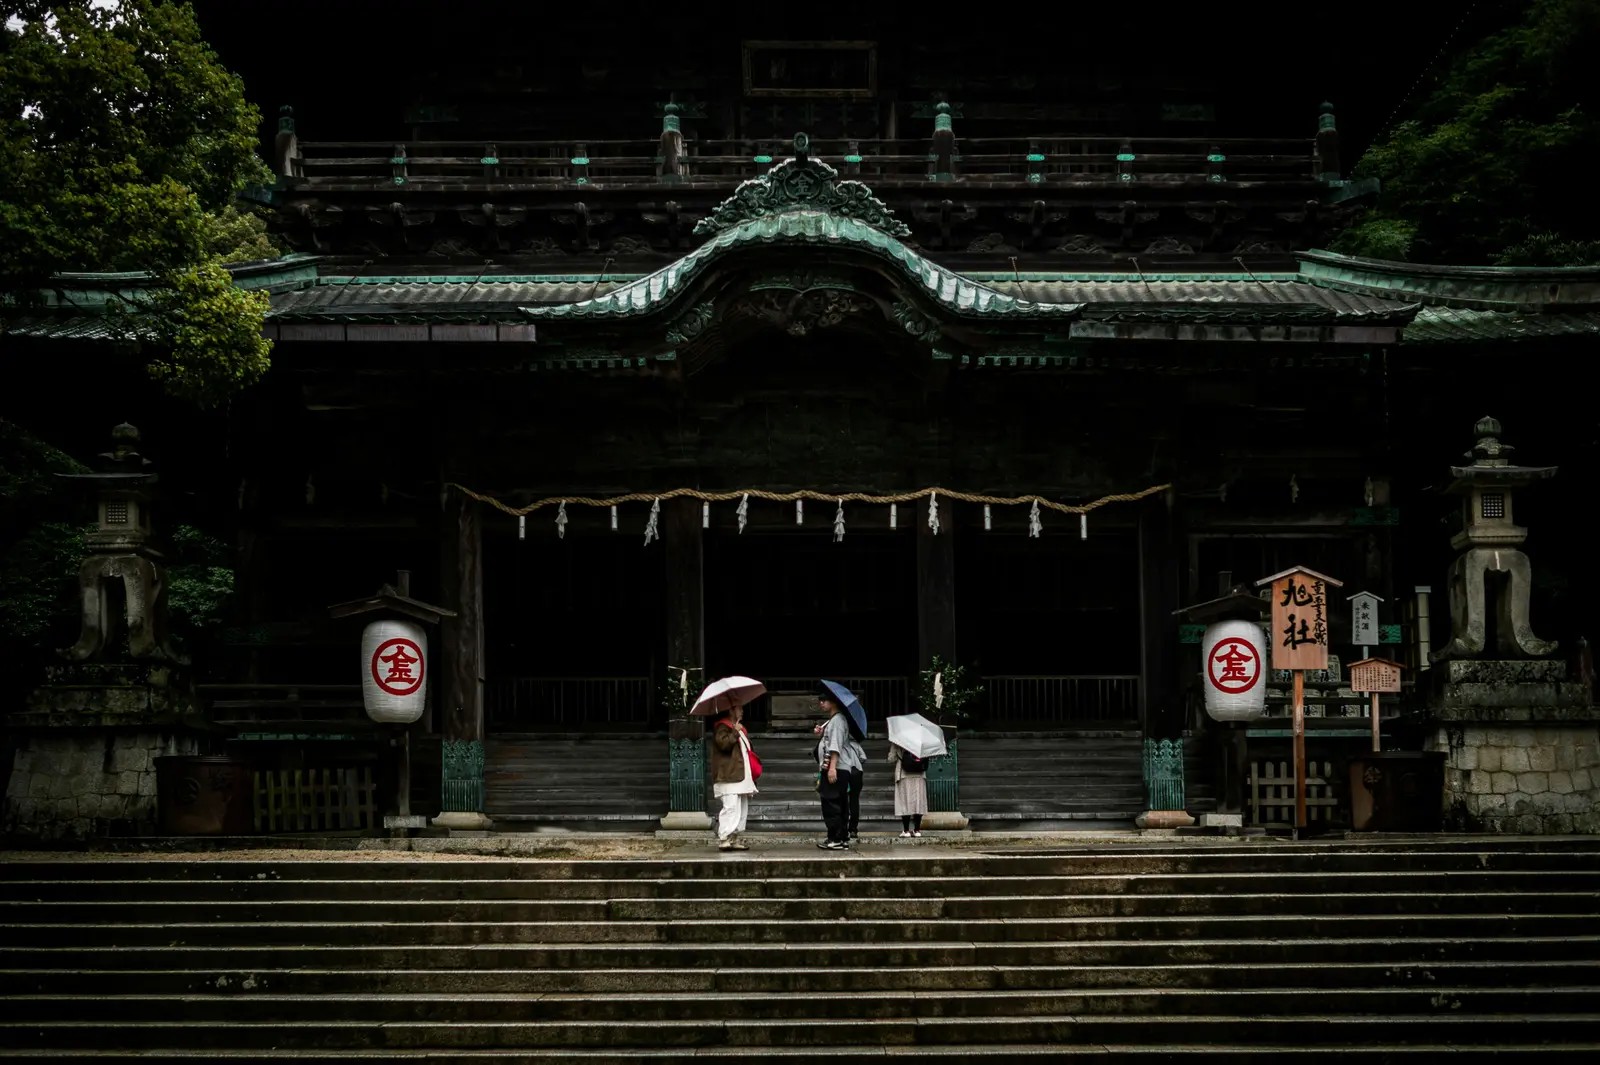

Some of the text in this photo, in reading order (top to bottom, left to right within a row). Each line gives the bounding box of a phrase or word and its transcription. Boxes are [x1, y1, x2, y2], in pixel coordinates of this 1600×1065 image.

[1280, 578, 1317, 650] 旭社
[380, 645, 419, 685] 金
[1214, 644, 1253, 683] 金
